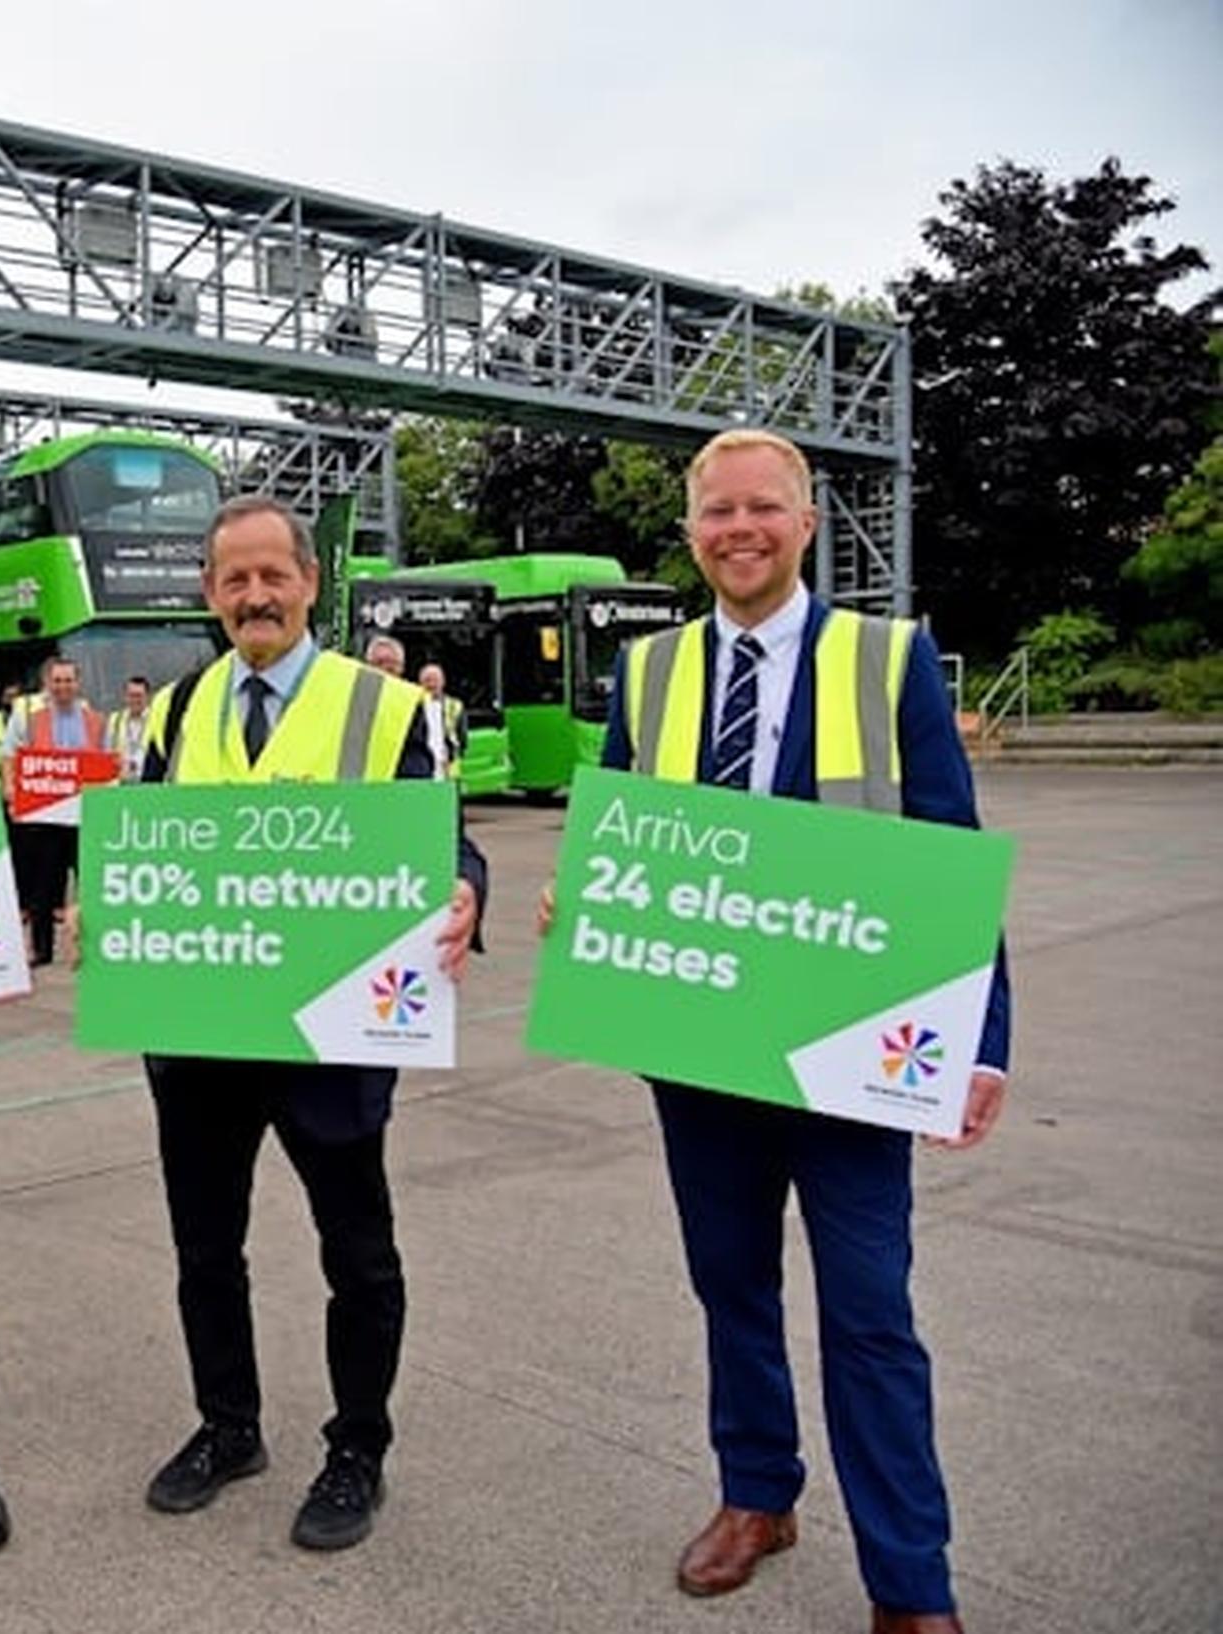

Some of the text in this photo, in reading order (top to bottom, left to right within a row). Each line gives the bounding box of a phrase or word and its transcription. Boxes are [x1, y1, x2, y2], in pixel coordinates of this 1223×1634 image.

[22, 756, 78, 776] great
[104, 806, 353, 852] June 2024
[593, 798, 751, 865] Arriva
[102, 864, 429, 909] 50% network
[582, 856, 890, 953] 24 electric
[101, 918, 283, 965] electric
[572, 915, 740, 989] buses
